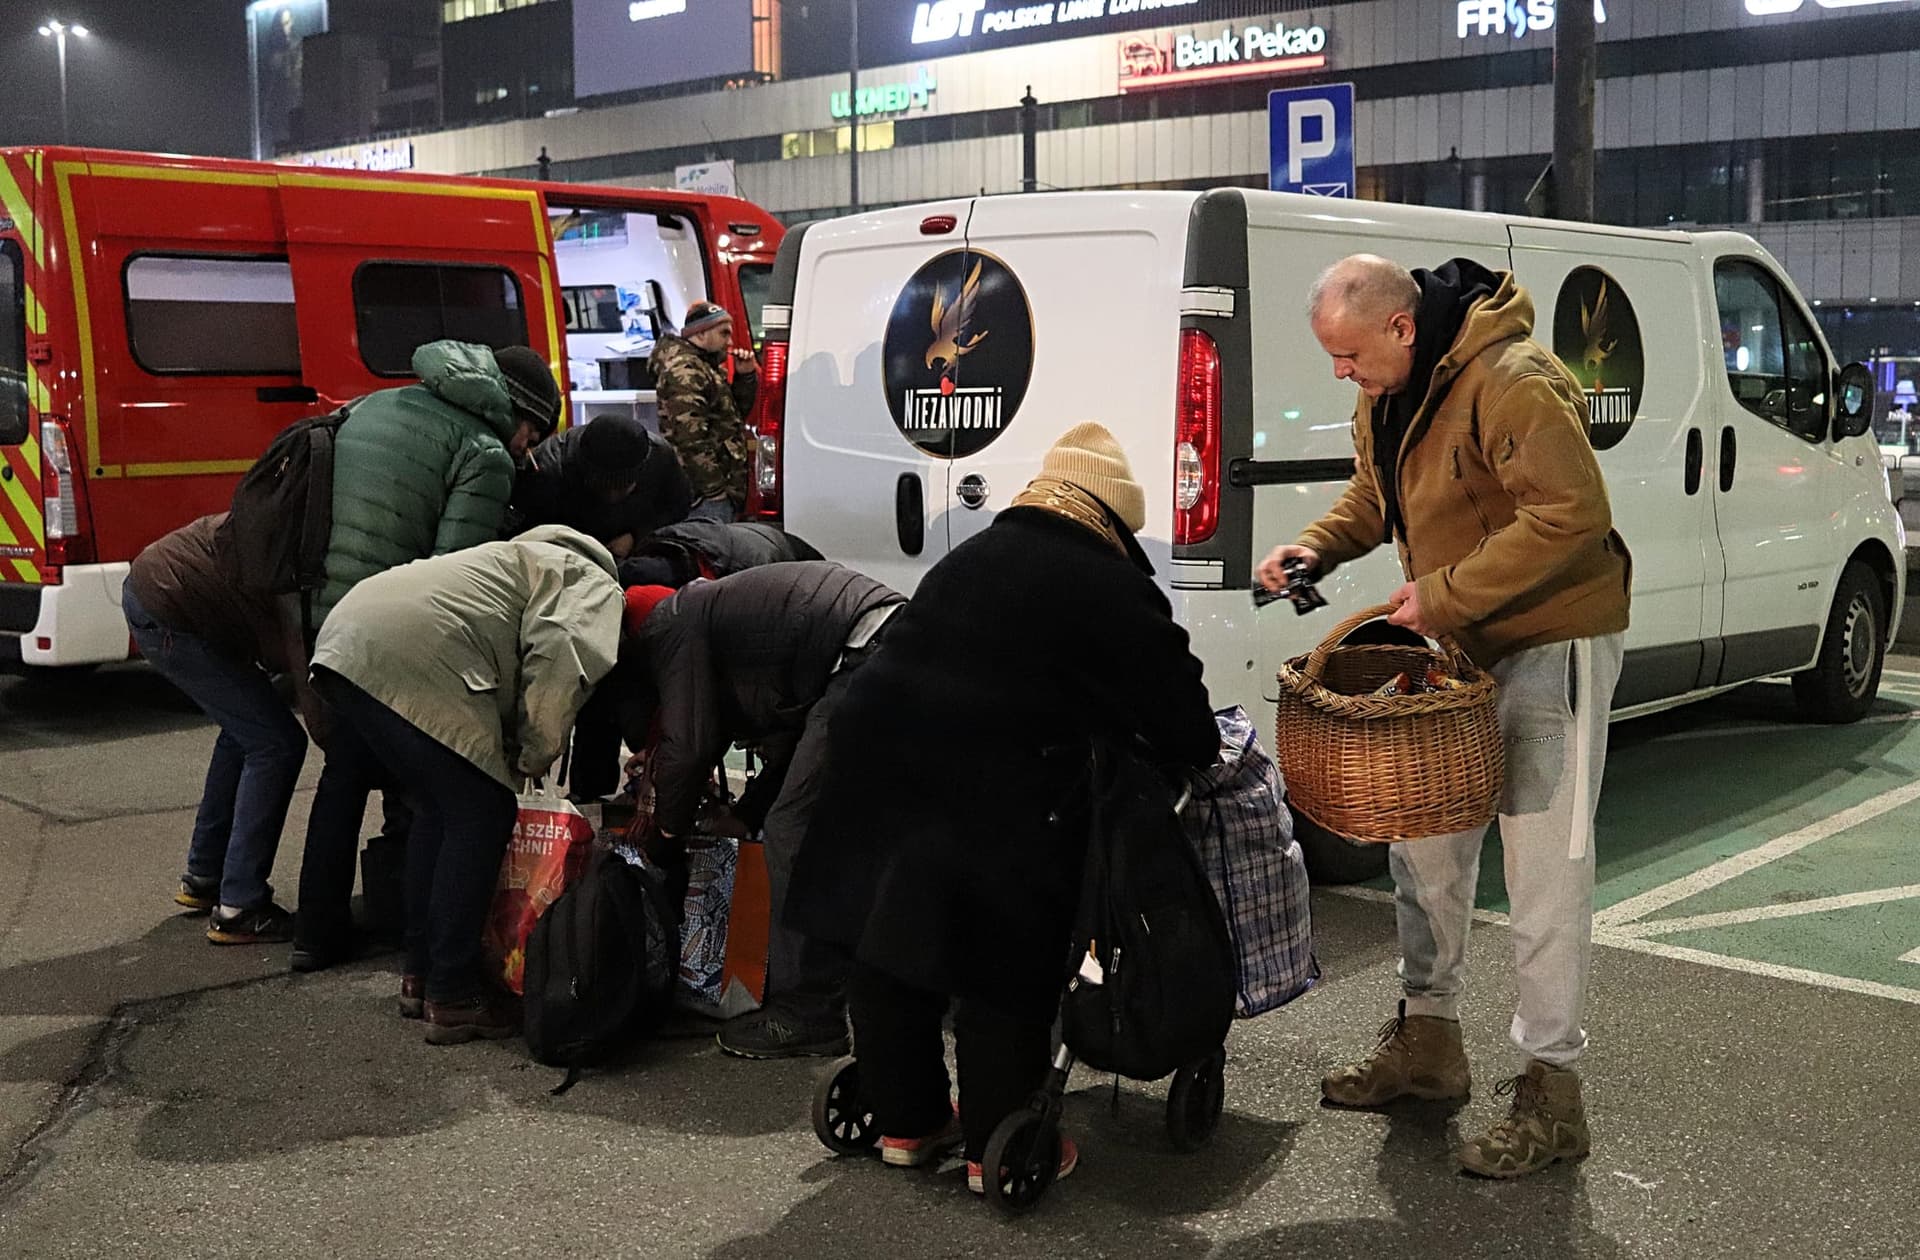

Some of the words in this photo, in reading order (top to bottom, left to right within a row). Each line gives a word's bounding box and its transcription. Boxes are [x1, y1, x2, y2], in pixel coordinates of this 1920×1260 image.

[981, 3, 1055, 34] POLSKIE
[1175, 30, 1240, 68] Bank
[1244, 22, 1325, 60] Pekao
[362, 140, 411, 171] Poland
[1288, 99, 1335, 183] P
[904, 387, 1002, 429] NIEZAWODNI
[1584, 387, 1630, 424] ZAWODNI
[506, 838, 553, 856] CHNI!
[526, 822, 573, 841] SZEFA
